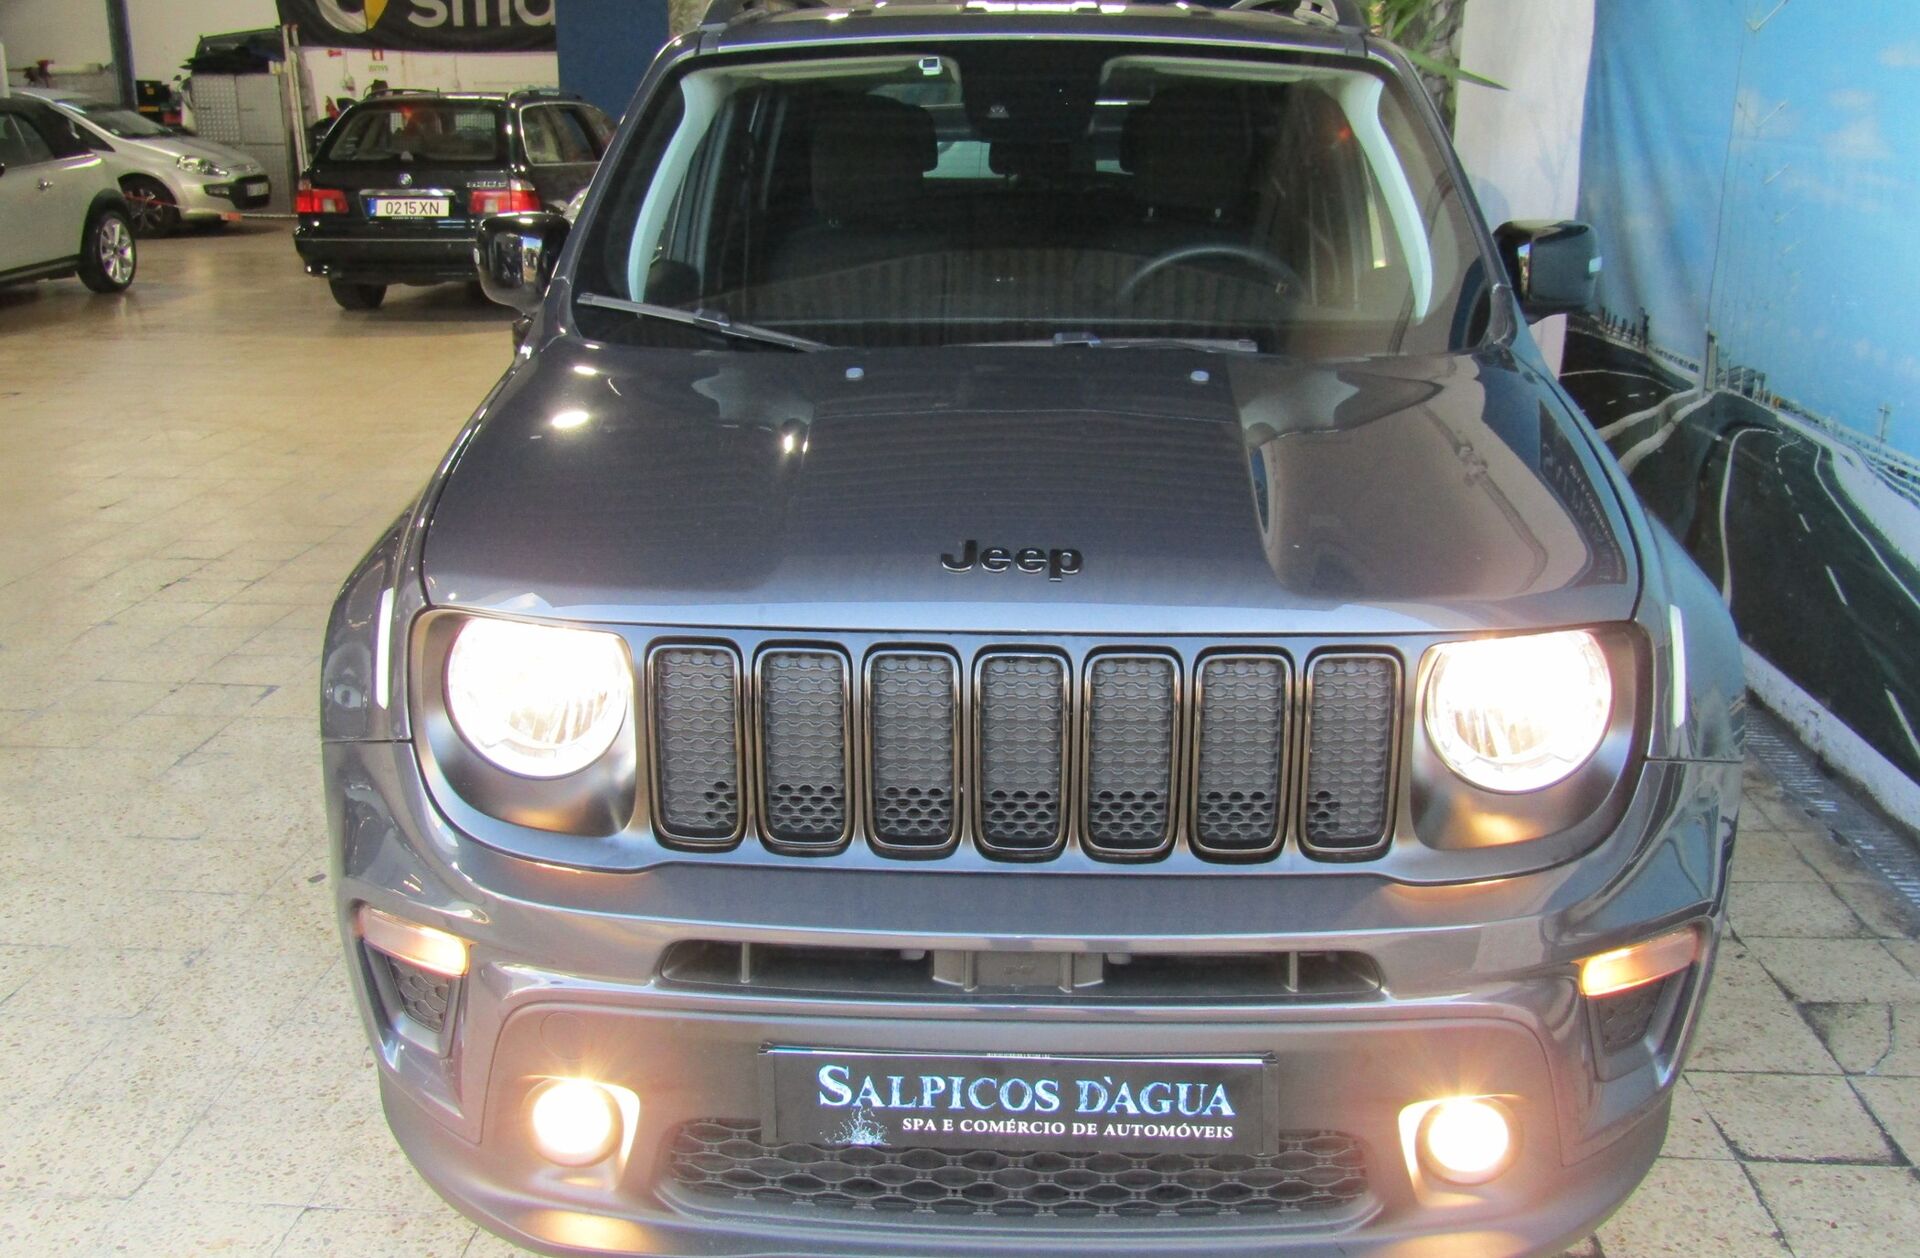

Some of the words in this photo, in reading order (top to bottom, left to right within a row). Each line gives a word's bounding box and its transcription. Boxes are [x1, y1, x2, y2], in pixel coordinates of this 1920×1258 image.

[940, 539, 1083, 582] Jeep
[818, 1064, 1059, 1112] SALPICOS
[902, 1117, 936, 1132] SPA
[943, 1118, 955, 1132] E
[960, 1117, 1065, 1135] COMÉRCIO
[1072, 1121, 1098, 1135] DE
[1103, 1122, 1234, 1139] AUTOMÓVEIS
